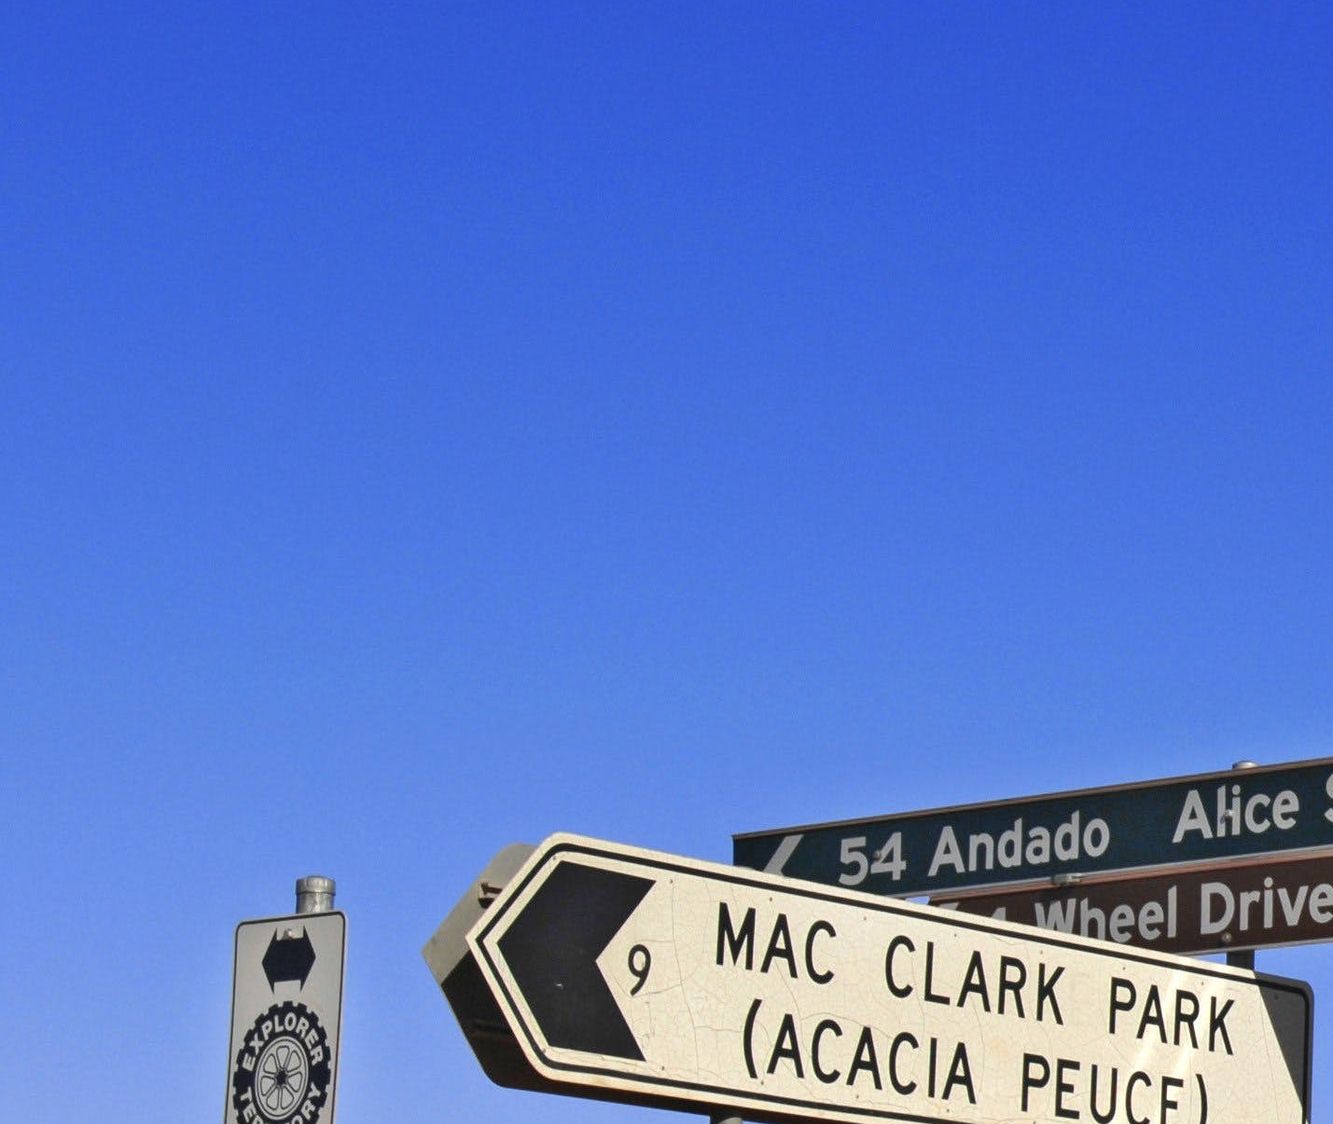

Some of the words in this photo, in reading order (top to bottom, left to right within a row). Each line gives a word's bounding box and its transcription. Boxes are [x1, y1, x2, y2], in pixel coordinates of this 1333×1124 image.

[839, 832, 906, 886] 54
[927, 810, 1110, 877] Andado
[1171, 784, 1300, 844] Alice
[1034, 885, 1177, 943] Wheel
[627, 943, 652, 997] 9
[714, 901, 837, 985] MAC
[884, 934, 1066, 1026] CLARK
[1108, 975, 1235, 1056] PARK
[242, 1012, 324, 1072] EXPLORER
[743, 998, 977, 1105] (ACACIA
